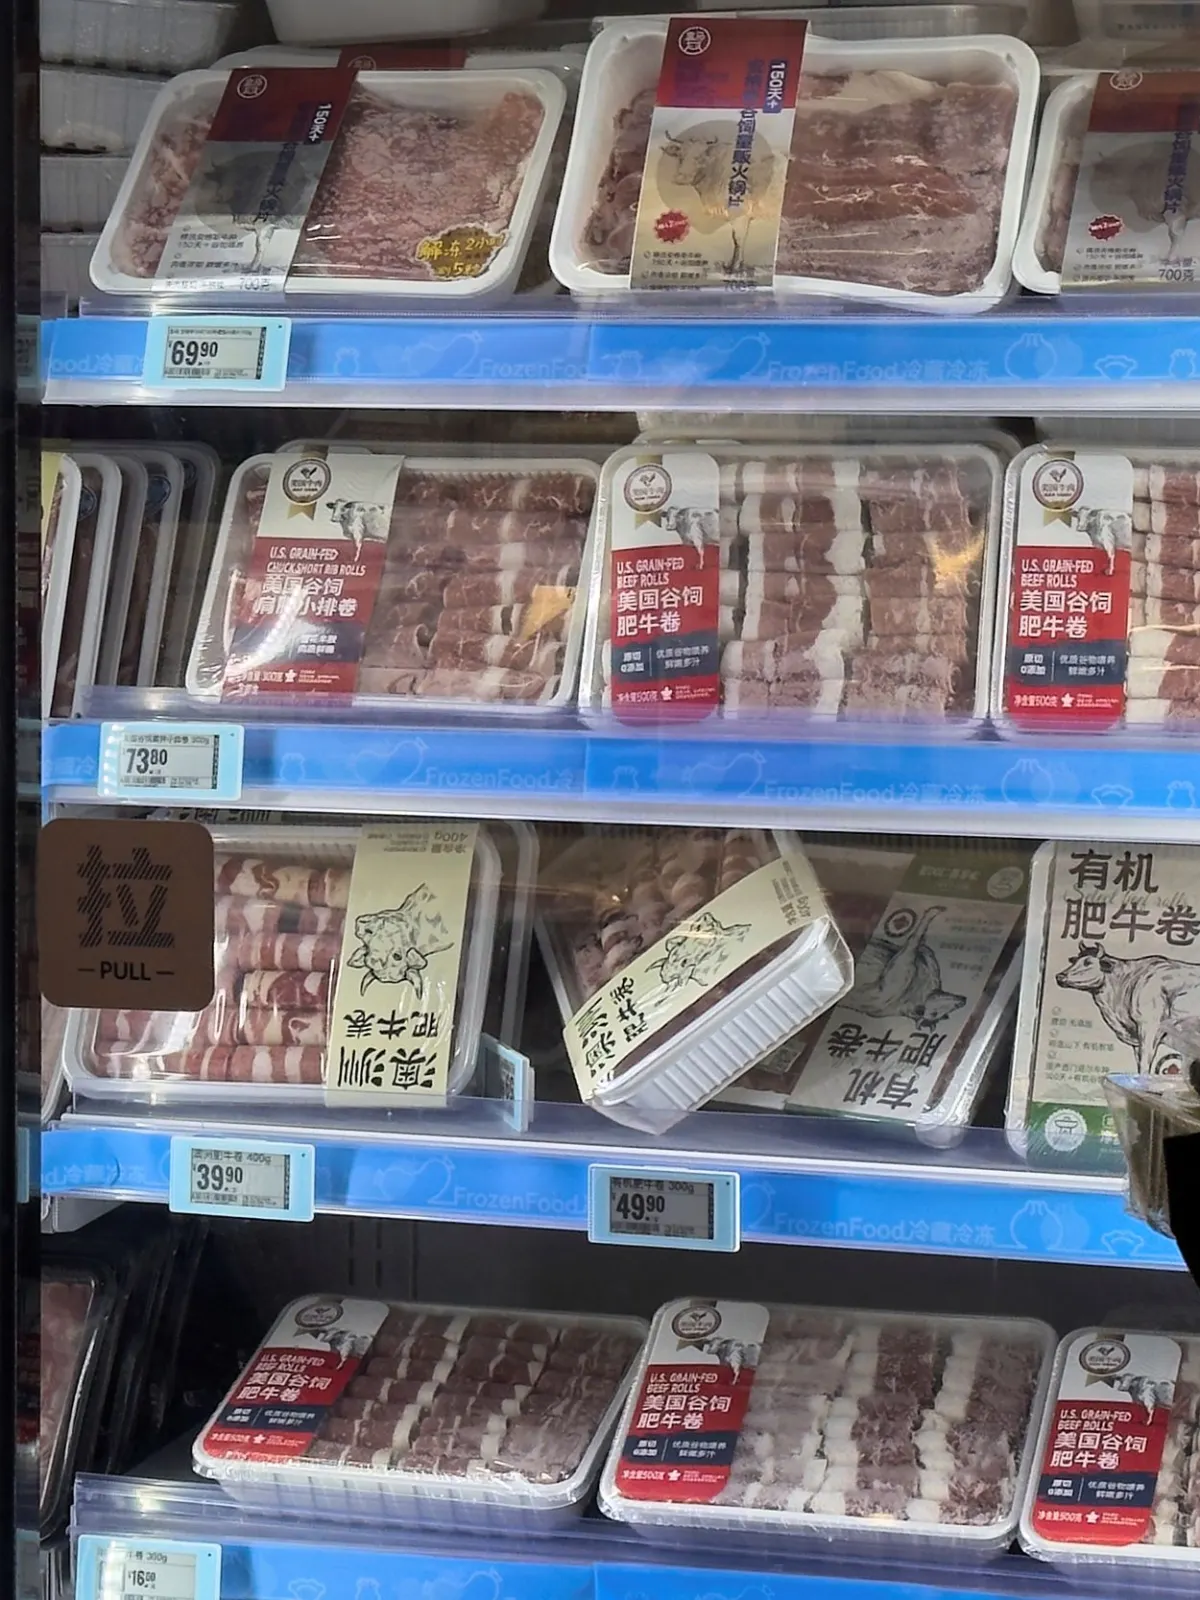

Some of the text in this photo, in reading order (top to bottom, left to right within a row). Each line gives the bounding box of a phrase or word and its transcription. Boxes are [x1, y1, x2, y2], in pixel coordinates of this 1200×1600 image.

[270, 547, 286, 559] U.S.
[616, 557, 684, 574] U.S. GRAIN-FED
[1022, 559, 1094, 573] U.S. GRAIN-FED
[641, 573, 669, 587] ROLLS
[1047, 575, 1077, 588] ROLLS
[617, 586, 703, 613] 美国谷饲
[1020, 590, 1112, 614] 美国谷饲
[617, 611, 681, 636] 肥牛卷
[1019, 615, 1088, 638] 肥牛卷
[1069, 849, 1159, 893] 有机
[77, 845, 175, 948] 拉
[100, 961, 151, 981] PULL
[610, 977, 648, 1042] 肥牛卷
[343, 1010, 438, 1039] 肥牛卷
[828, 1023, 947, 1068] 肥牛卷
[338, 1047, 437, 1090] 澳洲
[843, 1067, 918, 1109] 有机
[247, 1372, 332, 1391] 美国谷饲
[650, 1373, 667, 1383] U.S.
[237, 1386, 301, 1402] 肥牛卷
[671, 1384, 701, 1393] ROLLS
[642, 1394, 732, 1413] 美国谷饲
[636, 1412, 704, 1429] 肥牛卷
[1060, 1409, 1132, 1423] U.S. GRAIN-FED
[1083, 1421, 1114, 1431] ROLLS
[1054, 1431, 1147, 1453] 美国谷饲
[1050, 1450, 1119, 1469] 肥牛卷
